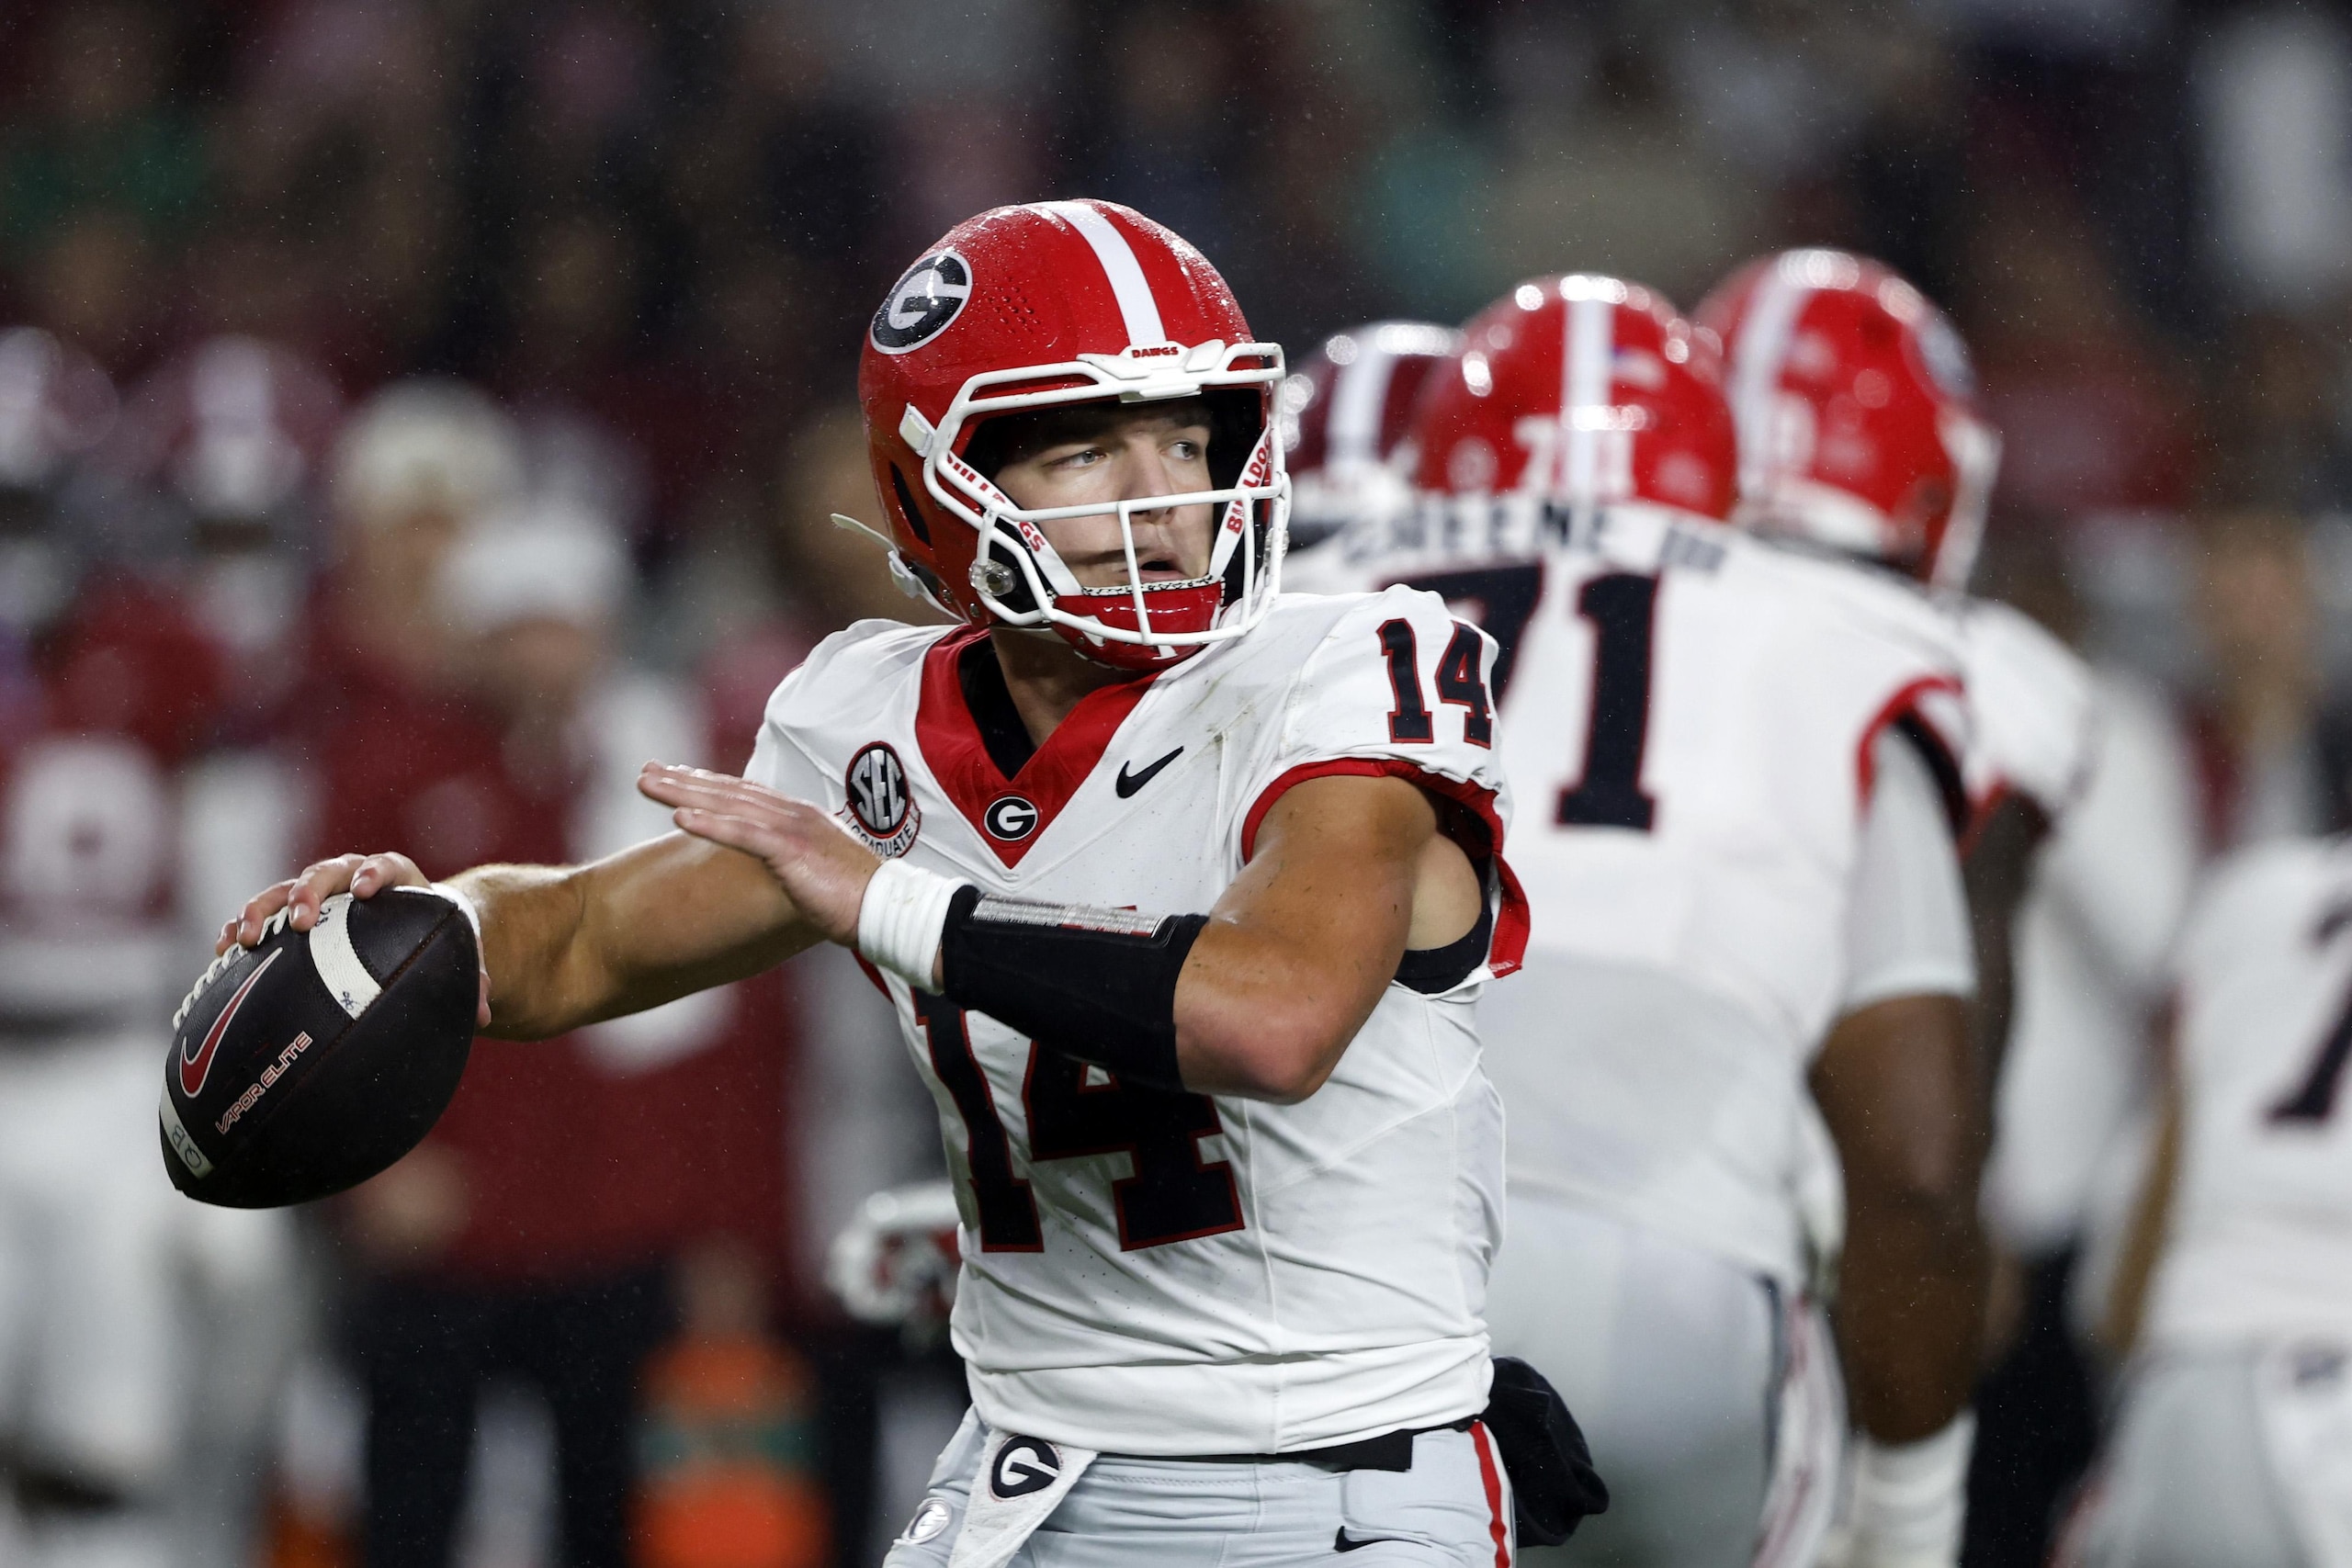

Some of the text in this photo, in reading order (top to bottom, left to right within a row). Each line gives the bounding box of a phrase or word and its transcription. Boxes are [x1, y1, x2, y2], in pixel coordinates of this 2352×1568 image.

[872, 255, 968, 348] G
[1131, 346, 1179, 358] DAWGS
[1376, 617, 1493, 750] 14
[1377, 558, 1661, 832] 71
[851, 749, 907, 830] SEC
[984, 795, 1037, 840] G
[215, 1030, 313, 1135] VAPOR ELITE
[910, 985, 1246, 1253] 14
[172, 1123, 202, 1169] QB
[990, 1434, 1060, 1499] G
